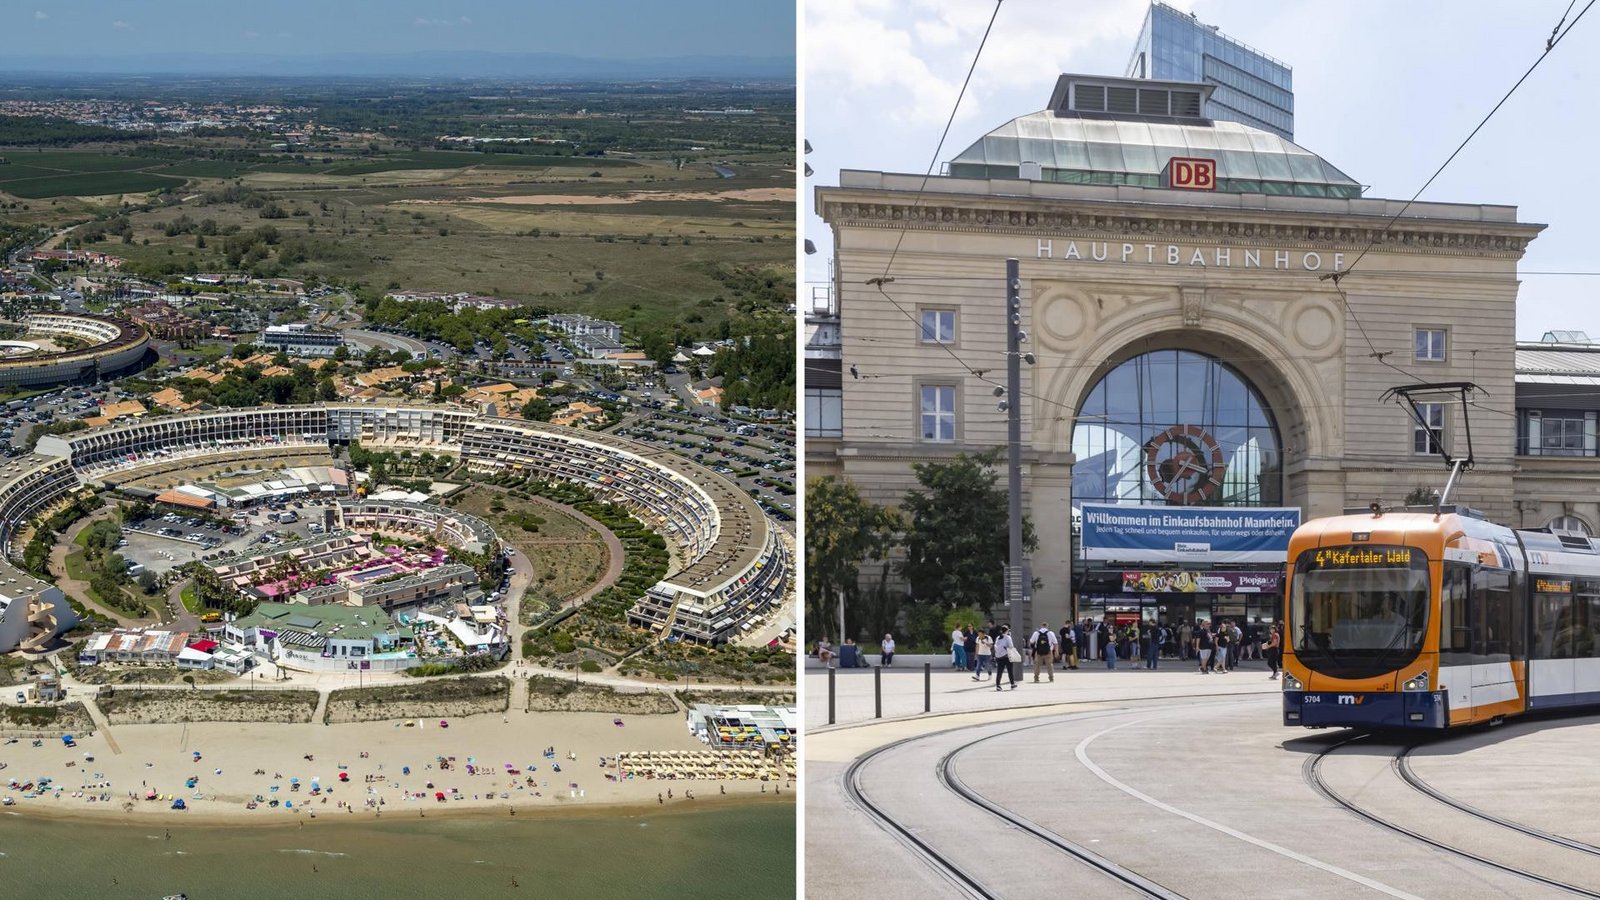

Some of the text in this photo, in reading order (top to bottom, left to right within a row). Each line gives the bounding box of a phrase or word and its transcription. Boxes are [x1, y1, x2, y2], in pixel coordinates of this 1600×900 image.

[1176, 162, 1211, 186] DB
[1037, 239, 1344, 272] HAUPTBAHNHOF
[1087, 512, 1147, 526] Willkommen
[1149, 515, 1161, 526] im
[1163, 515, 1243, 528] Einkaufsbahnhof
[1244, 516, 1296, 528] Mannheim.
[1114, 526, 1124, 535] Tag
[1158, 528, 1181, 536] bequem
[1182, 528, 1211, 536] einkaufen,
[1221, 530, 1251, 538] unterwegs
[1332, 550, 1383, 565] Käfertaler
[1387, 549, 1411, 563] Wald
[1304, 695, 1321, 703] 5704
